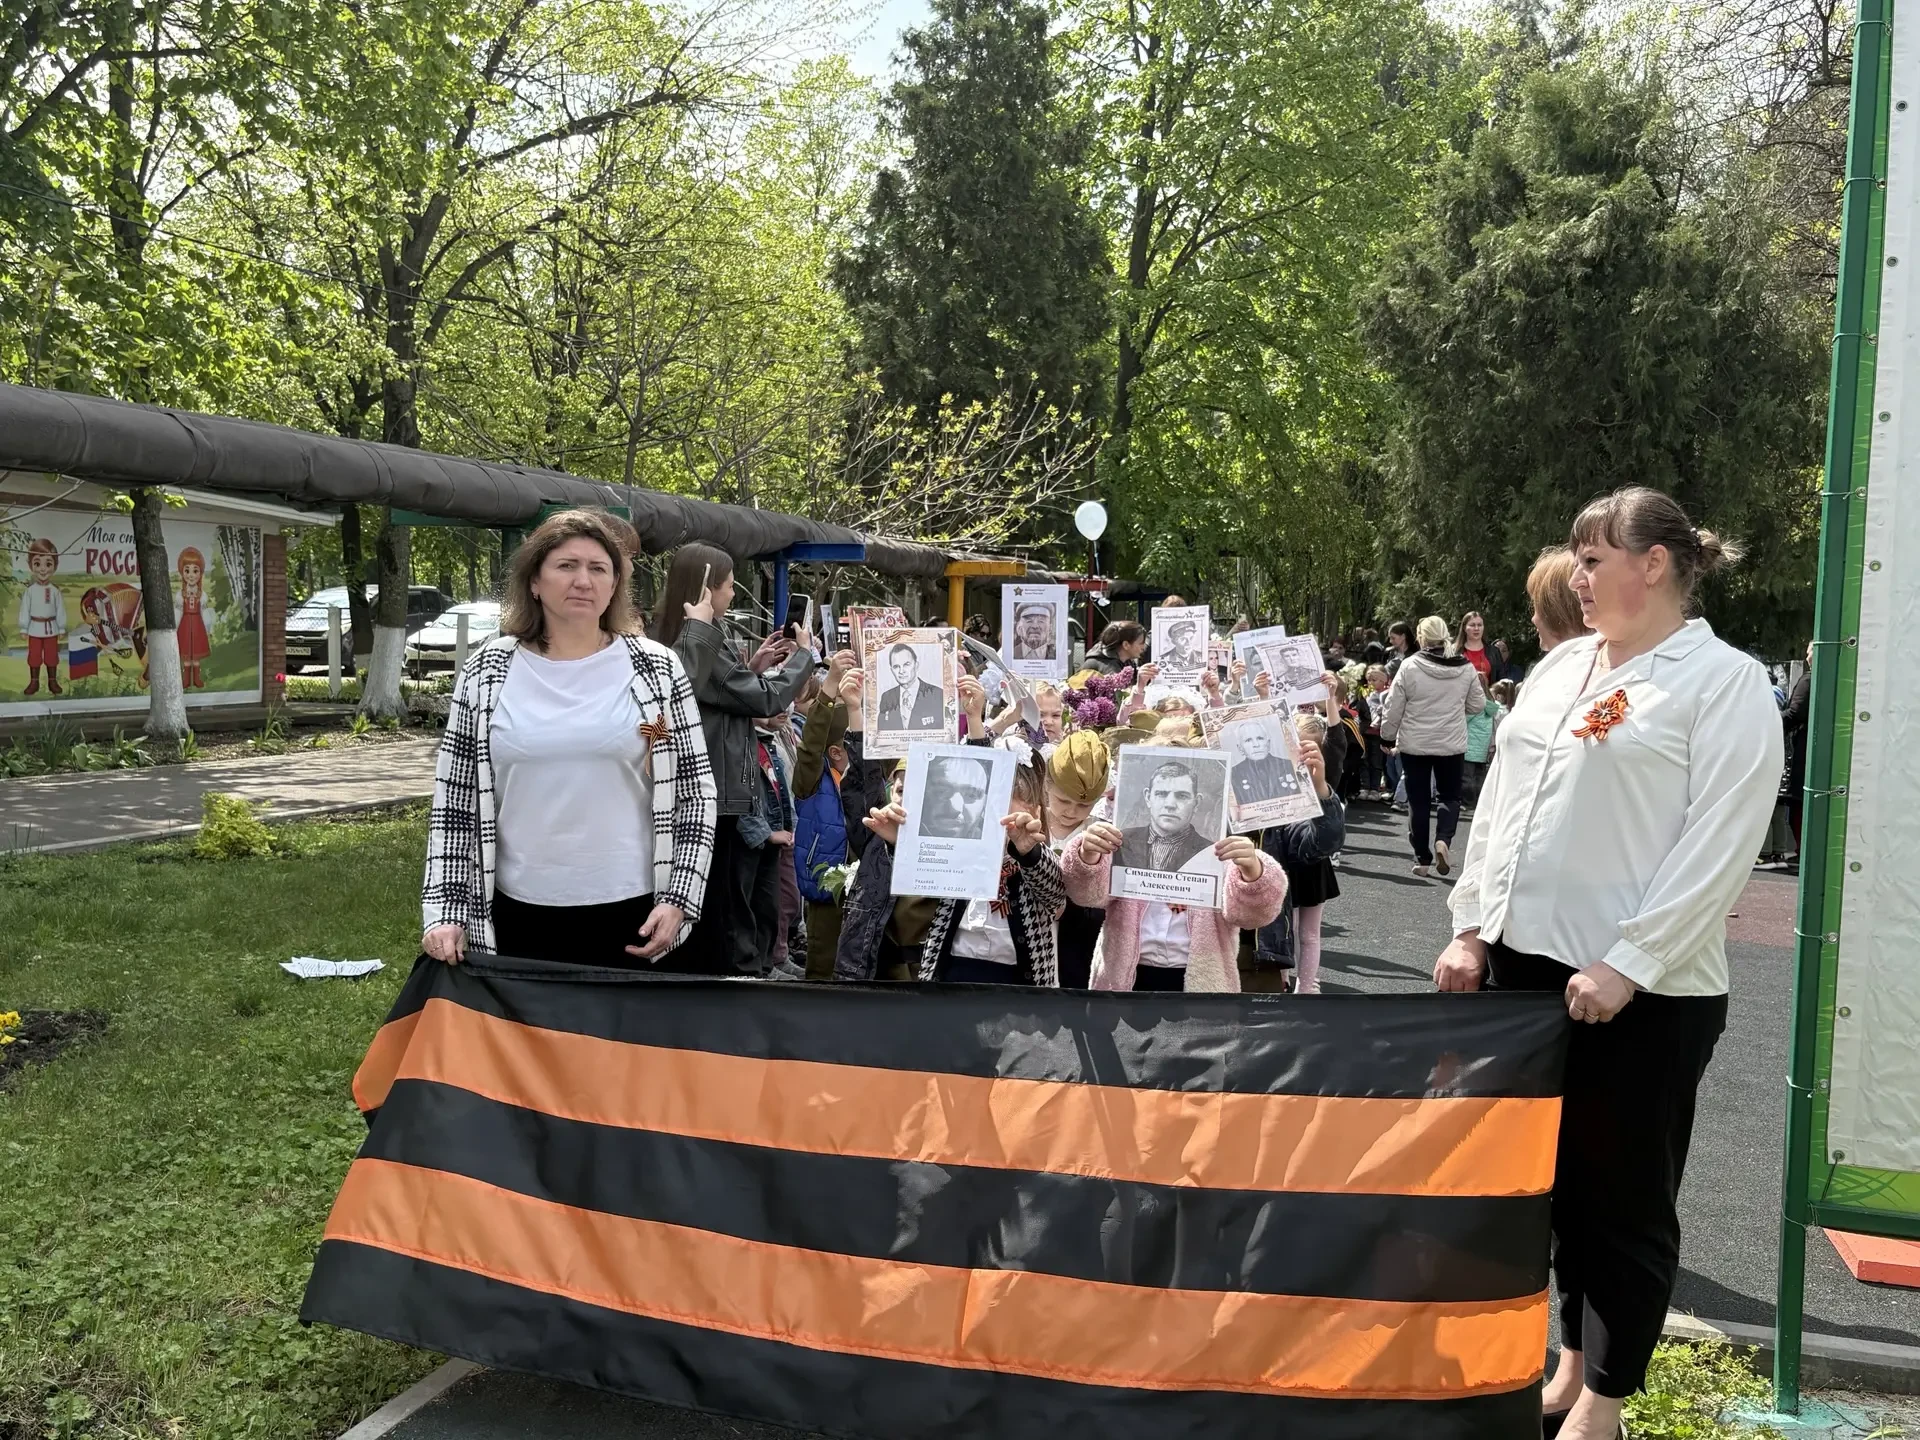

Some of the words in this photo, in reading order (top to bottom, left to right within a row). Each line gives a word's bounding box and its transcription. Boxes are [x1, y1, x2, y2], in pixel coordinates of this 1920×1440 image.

[86, 526, 116, 544] Моя
[85, 548, 141, 576] РОСС
[1124, 867, 1173, 880] Симасенко
[1175, 873, 1208, 884] Степан
[1139, 880, 1191, 892] Алексеевич
